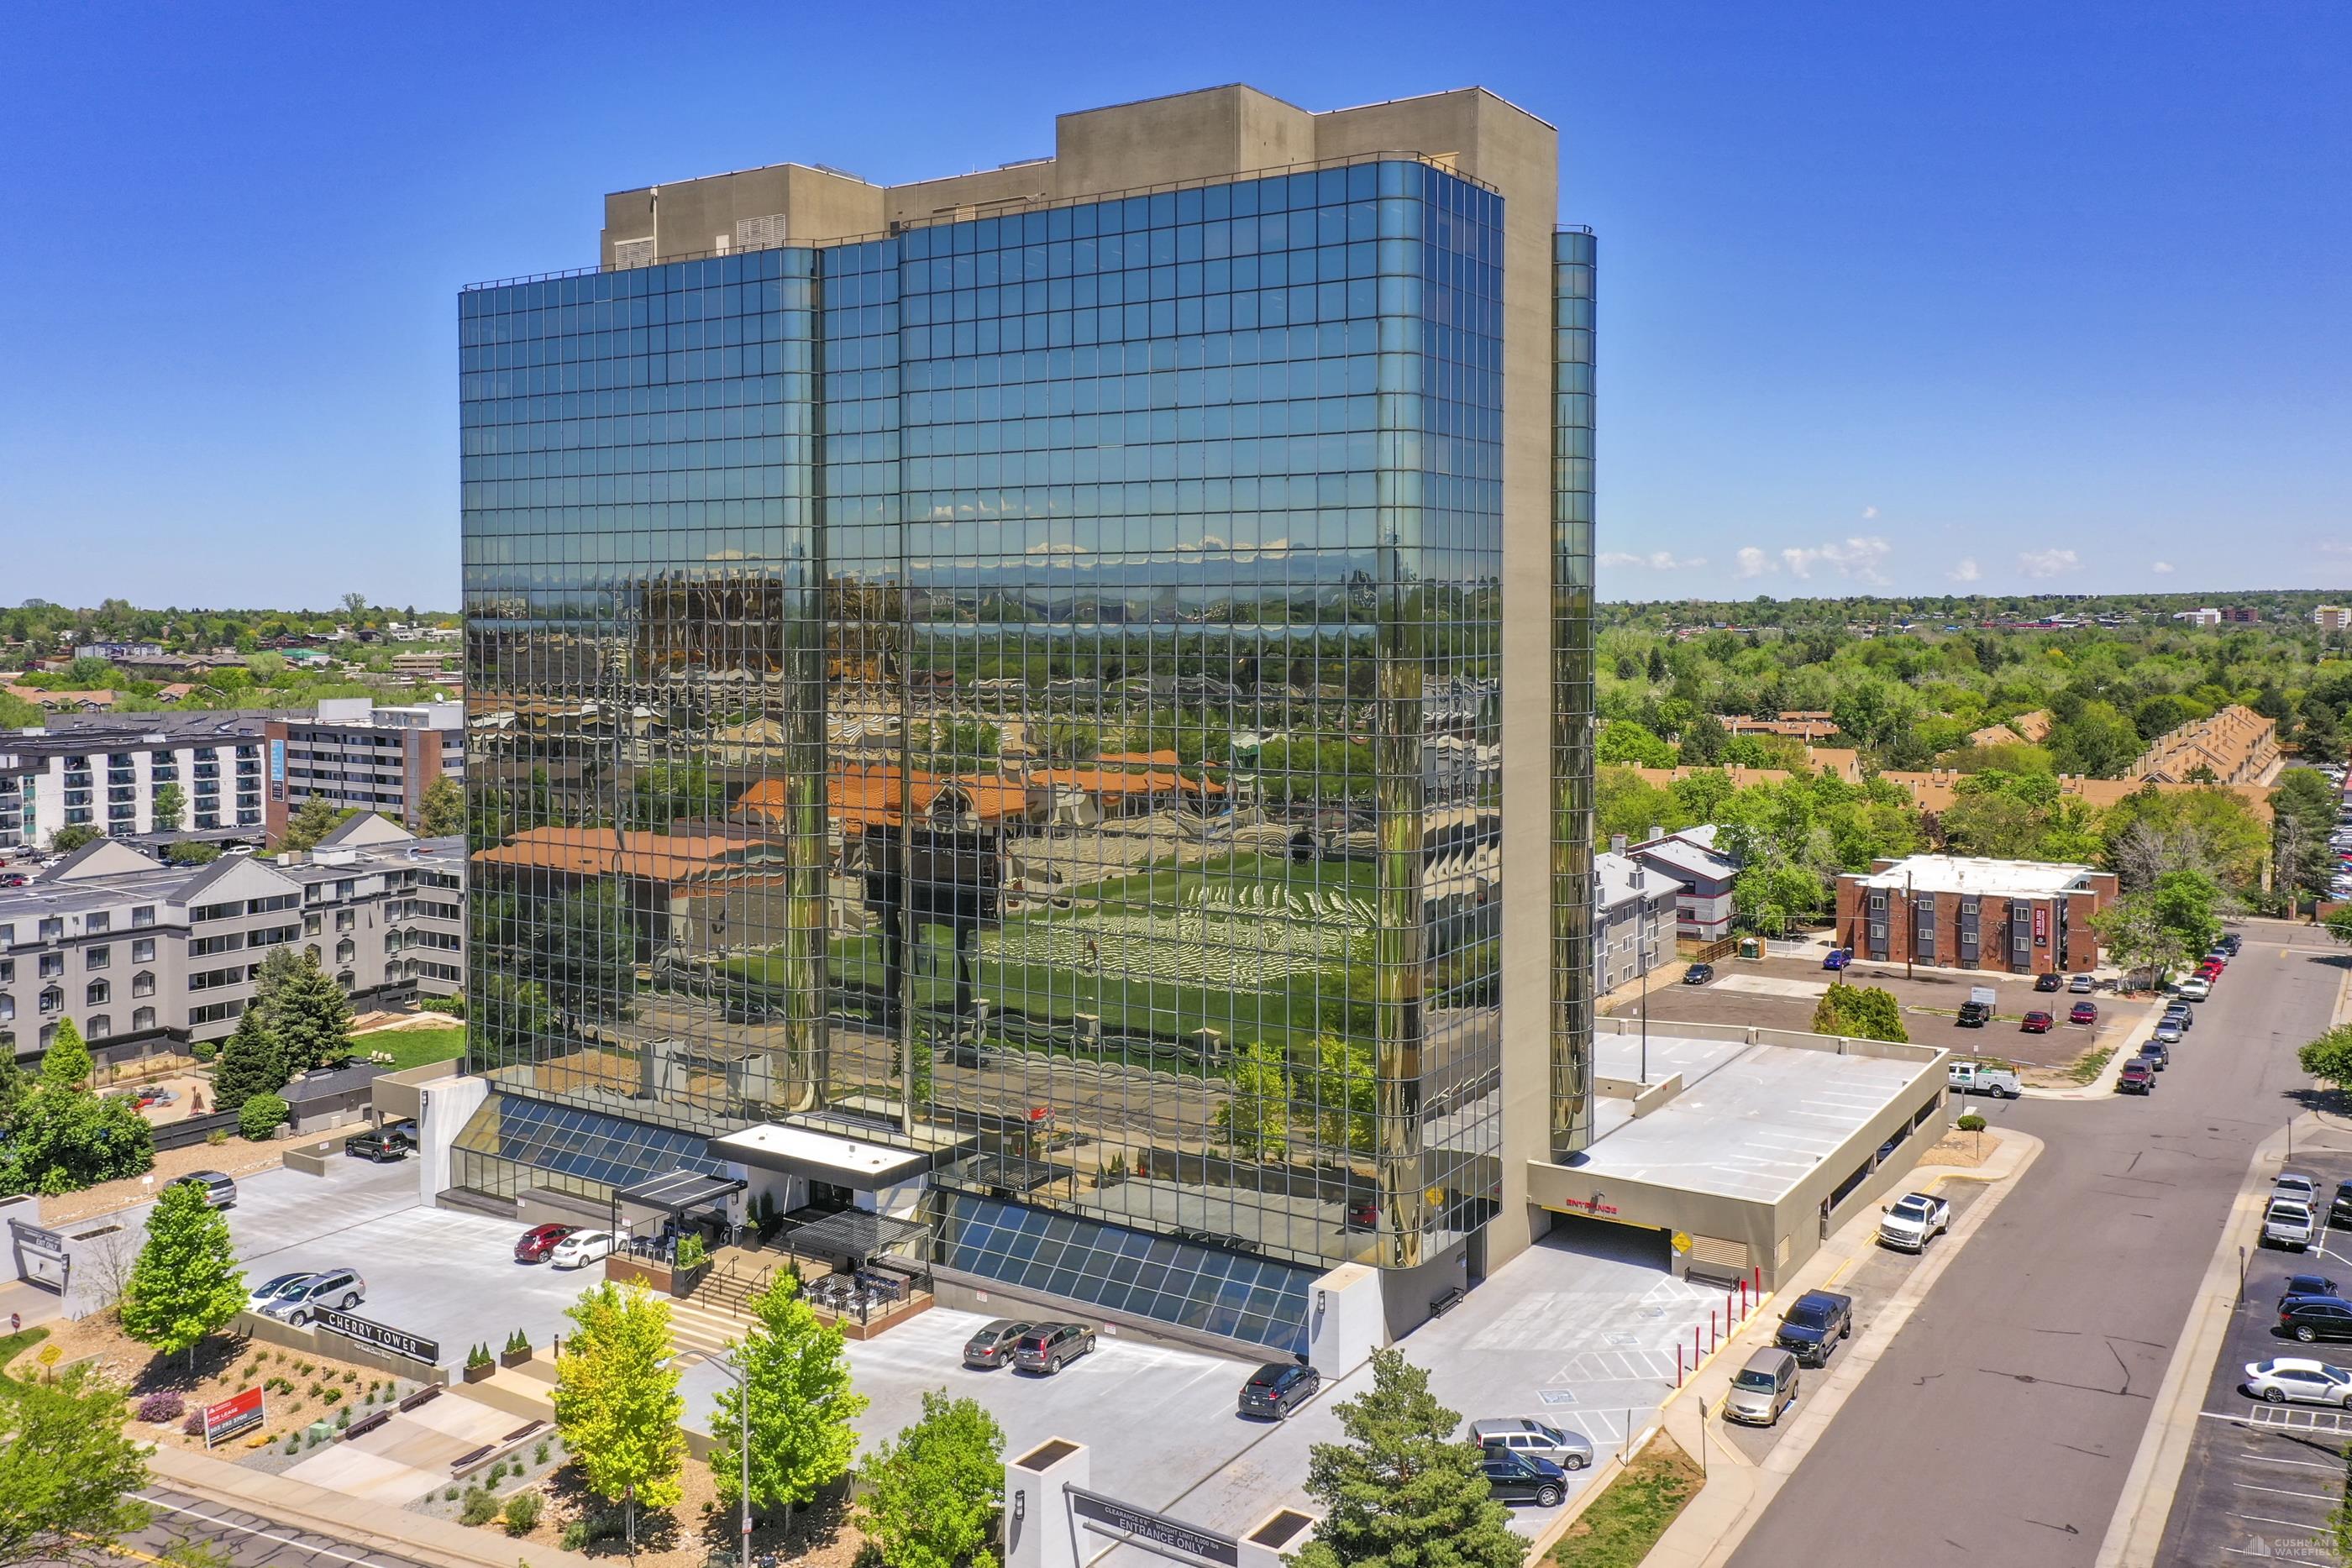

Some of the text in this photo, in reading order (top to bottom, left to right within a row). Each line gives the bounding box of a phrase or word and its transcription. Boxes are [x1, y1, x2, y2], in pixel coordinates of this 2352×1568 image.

[1566, 1198, 1618, 1214] ENTRANCE
[35, 1238, 46, 1247] EXIT
[45, 1241, 58, 1251] ONLY
[328, 1314, 417, 1353] CHERRY TOWER
[370, 1348, 381, 1357] Cherry
[208, 1414, 220, 1423] FOR
[220, 1407, 239, 1418] LEASE
[210, 1425, 221, 1434] 303
[233, 1413, 248, 1424] 3700
[1105, 1506, 1138, 1523] CLEARANCE
[1156, 1523, 1178, 1535] WEIGHT
[1179, 1531, 1194, 1542] LIMIT
[1210, 1541, 1219, 1550] lbs
[1119, 1518, 1205, 1555] ENTRANCE ONLY
